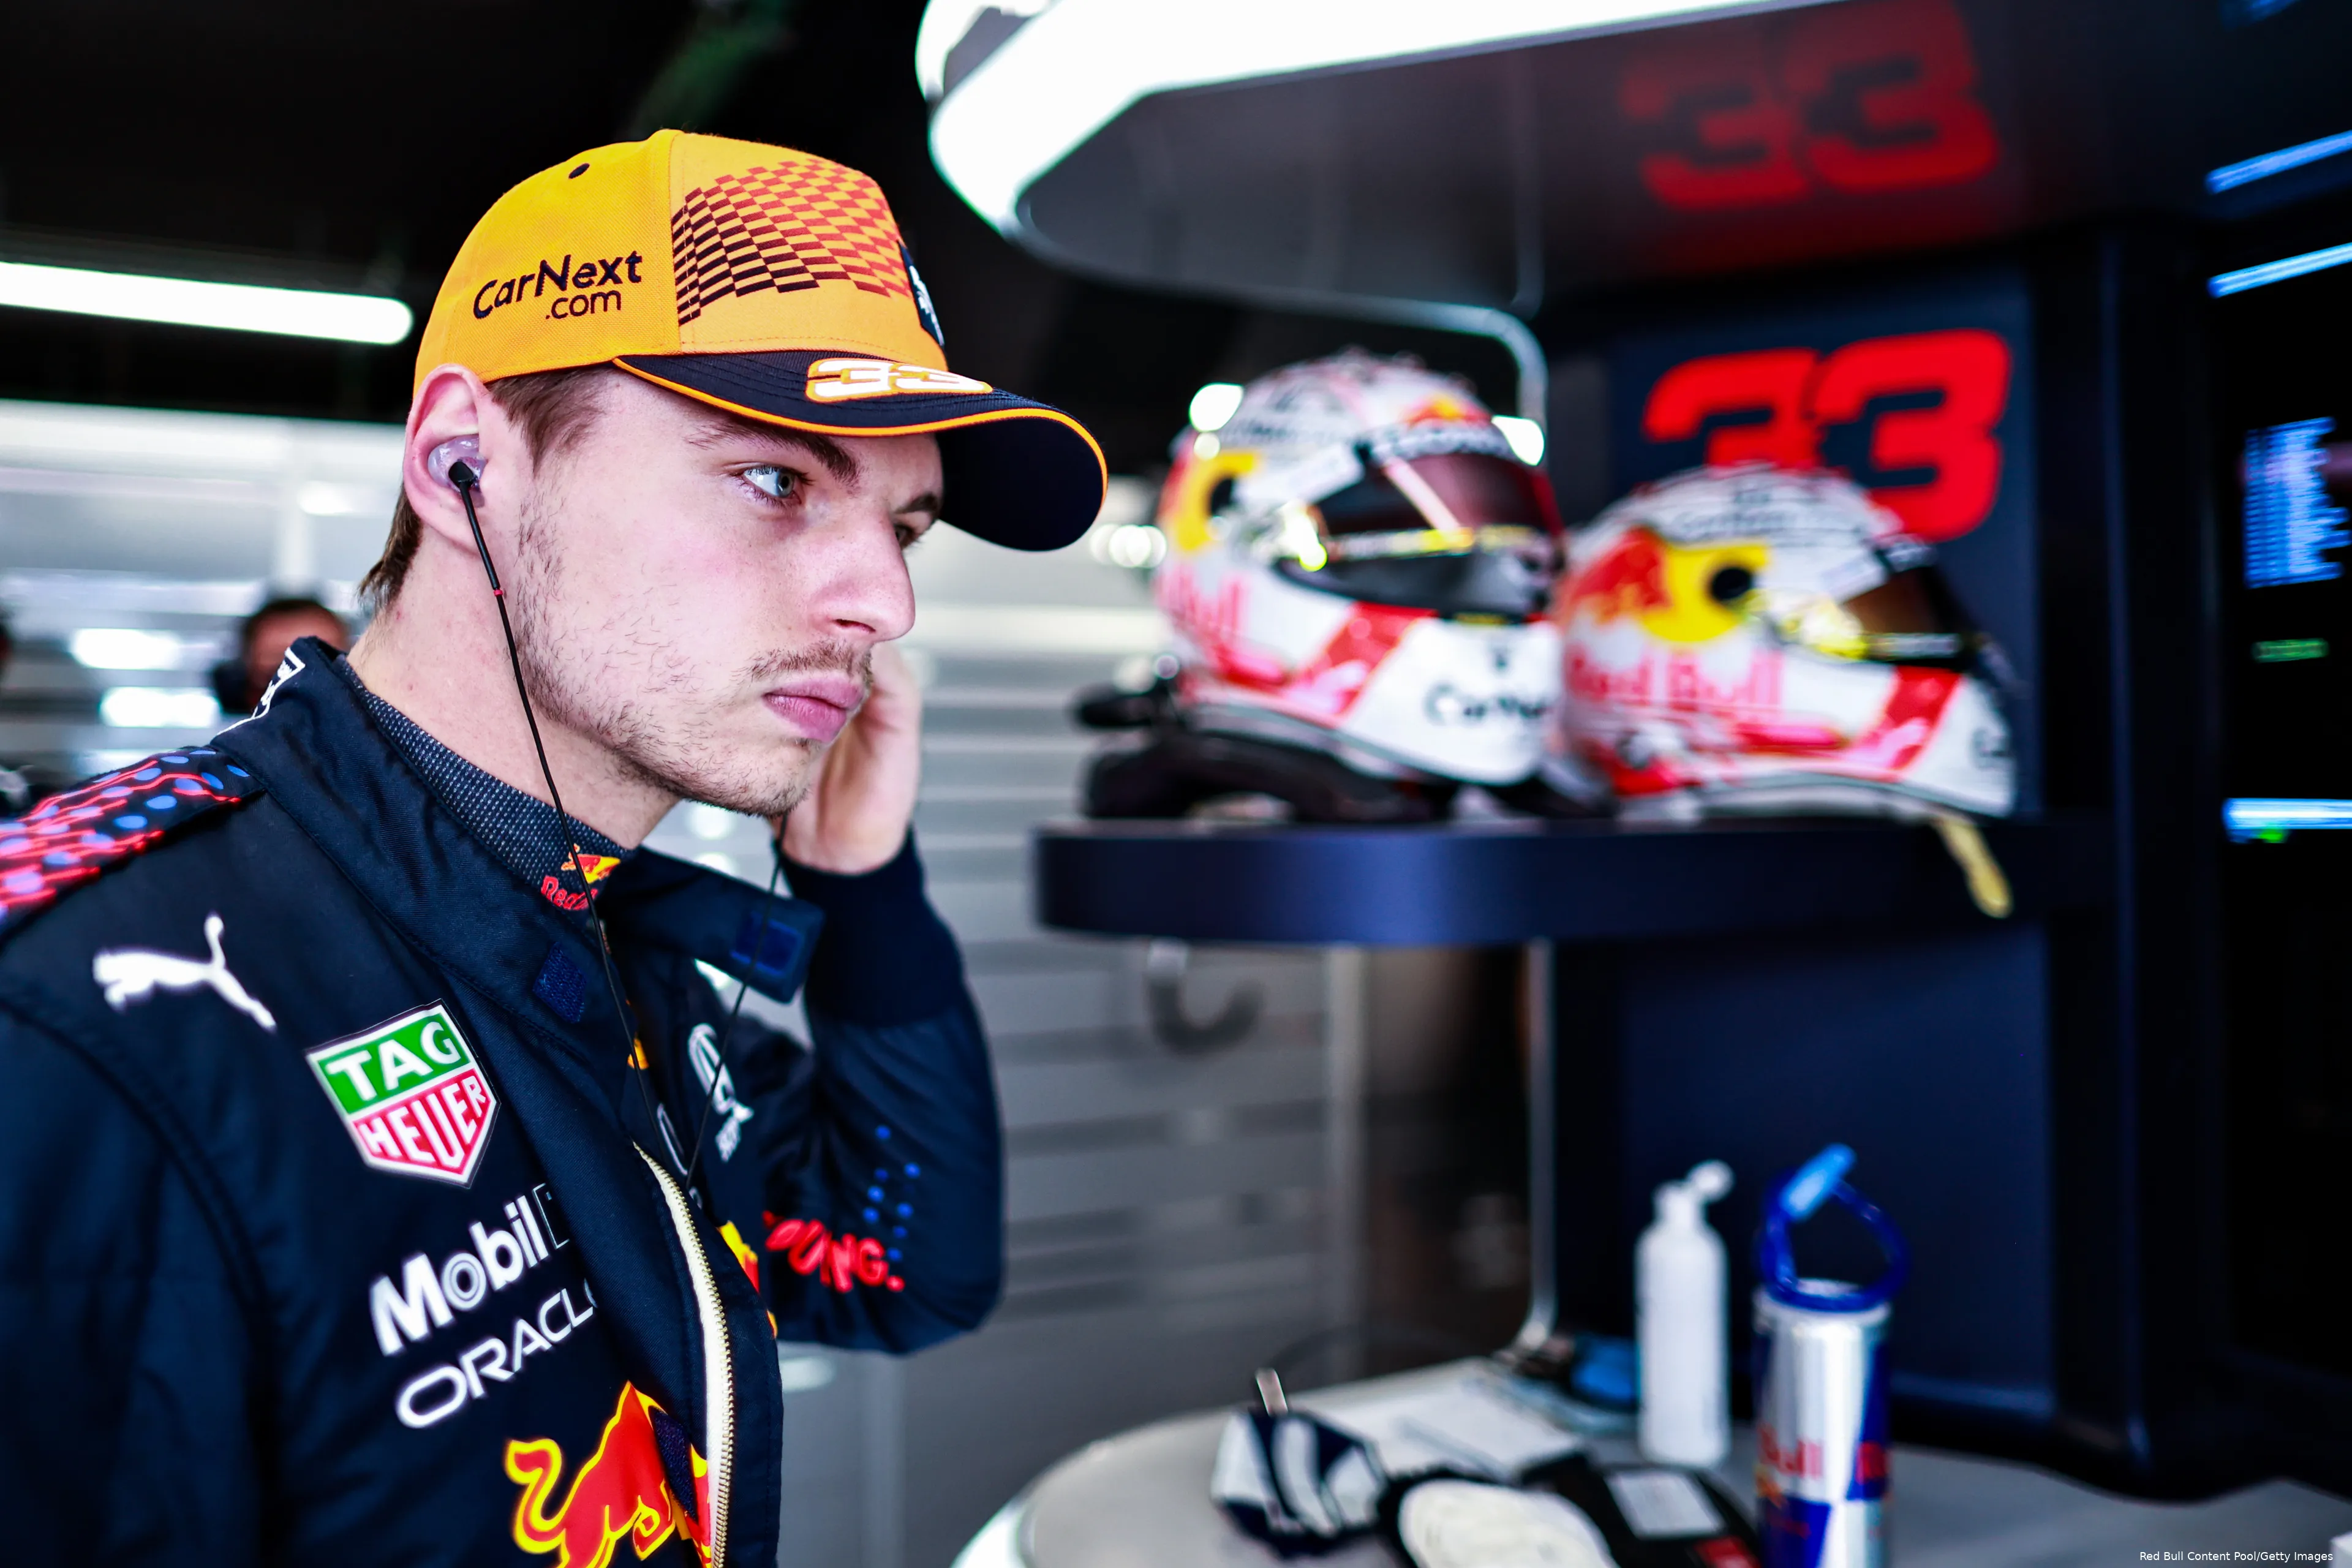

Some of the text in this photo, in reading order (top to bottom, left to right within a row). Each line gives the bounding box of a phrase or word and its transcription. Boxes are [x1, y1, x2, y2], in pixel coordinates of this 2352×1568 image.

[473, 251, 643, 319] CarNext
[545, 290, 622, 319] .com
[806, 357, 993, 403] 33
[1642, 328, 2012, 544] 33
[325, 1021, 461, 1101] TAG
[360, 1075, 486, 1168] HEUER
[369, 1194, 549, 1357] Mobil
[763, 1210, 907, 1293] OUNG.
[396, 1278, 598, 1428] ORACL
